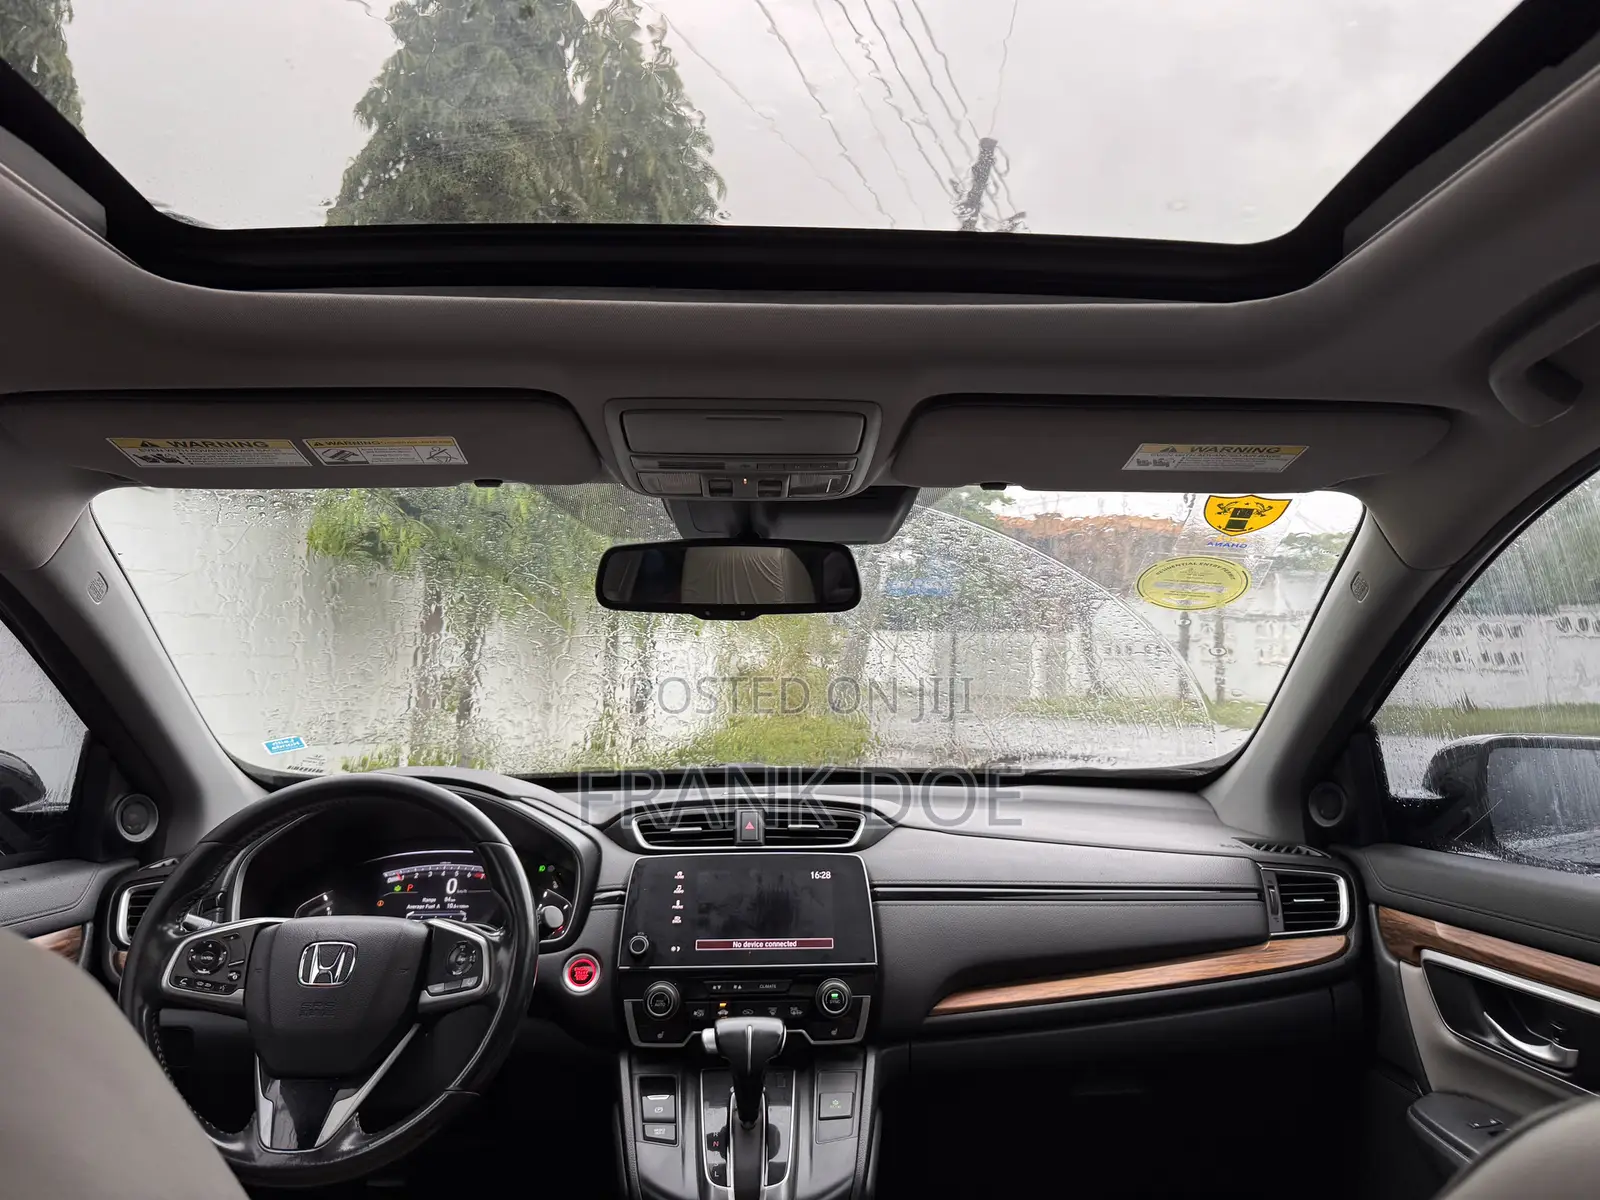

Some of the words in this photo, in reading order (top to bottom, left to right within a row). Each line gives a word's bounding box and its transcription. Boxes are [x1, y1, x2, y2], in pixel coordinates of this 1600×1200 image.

[166, 440, 270, 448] WARNING
[1189, 446, 1282, 454] WARNING
[1198, 561, 1221, 569] ENTRY
[810, 871, 832, 880] 16:28
[446, 878, 458, 895] 0
[732, 940, 743, 949] No
[743, 940, 764, 949] device
[764, 940, 797, 949] connected
